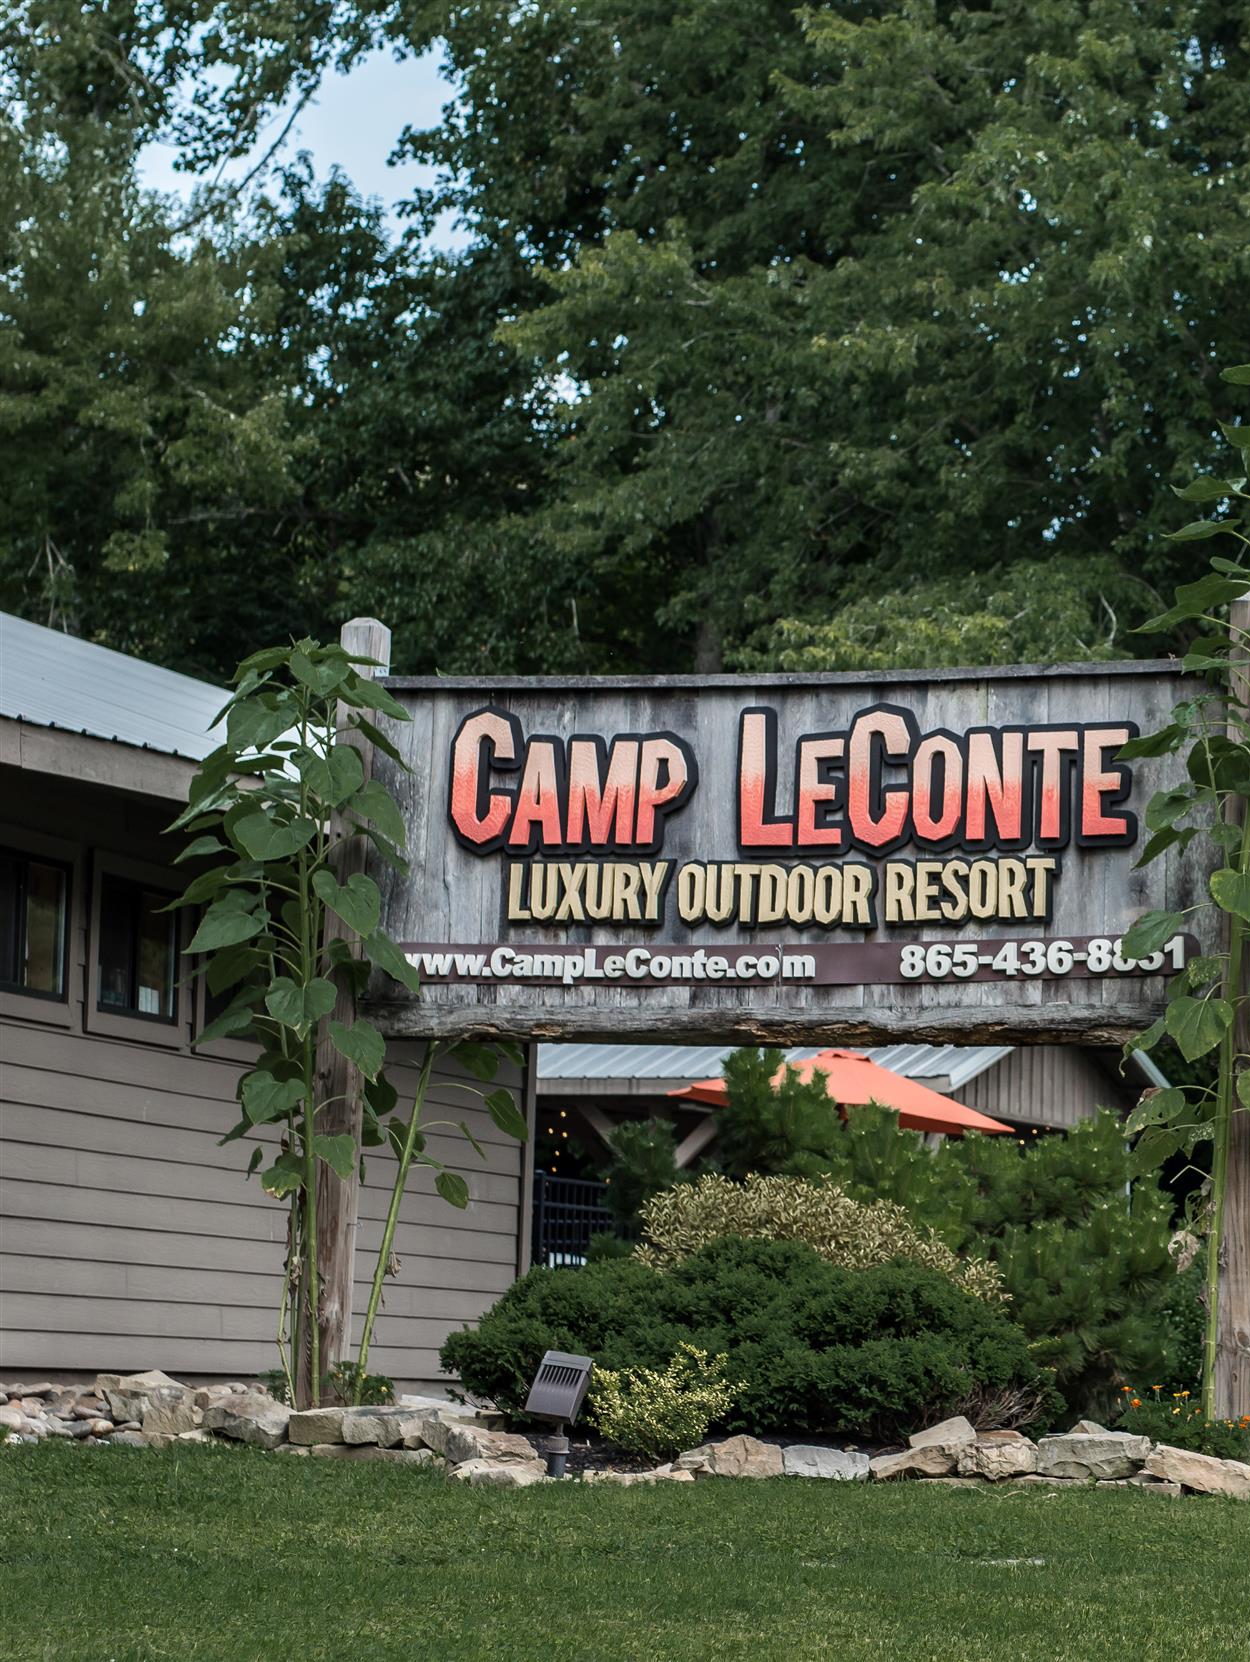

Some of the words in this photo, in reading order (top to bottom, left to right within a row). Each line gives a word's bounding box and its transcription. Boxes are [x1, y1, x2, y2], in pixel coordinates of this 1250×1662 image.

[449, 708, 692, 848] CAMP
[507, 861, 669, 922] LUXURY
[677, 862, 874, 925] OUTDOOR
[885, 857, 1057, 924] RESORT
